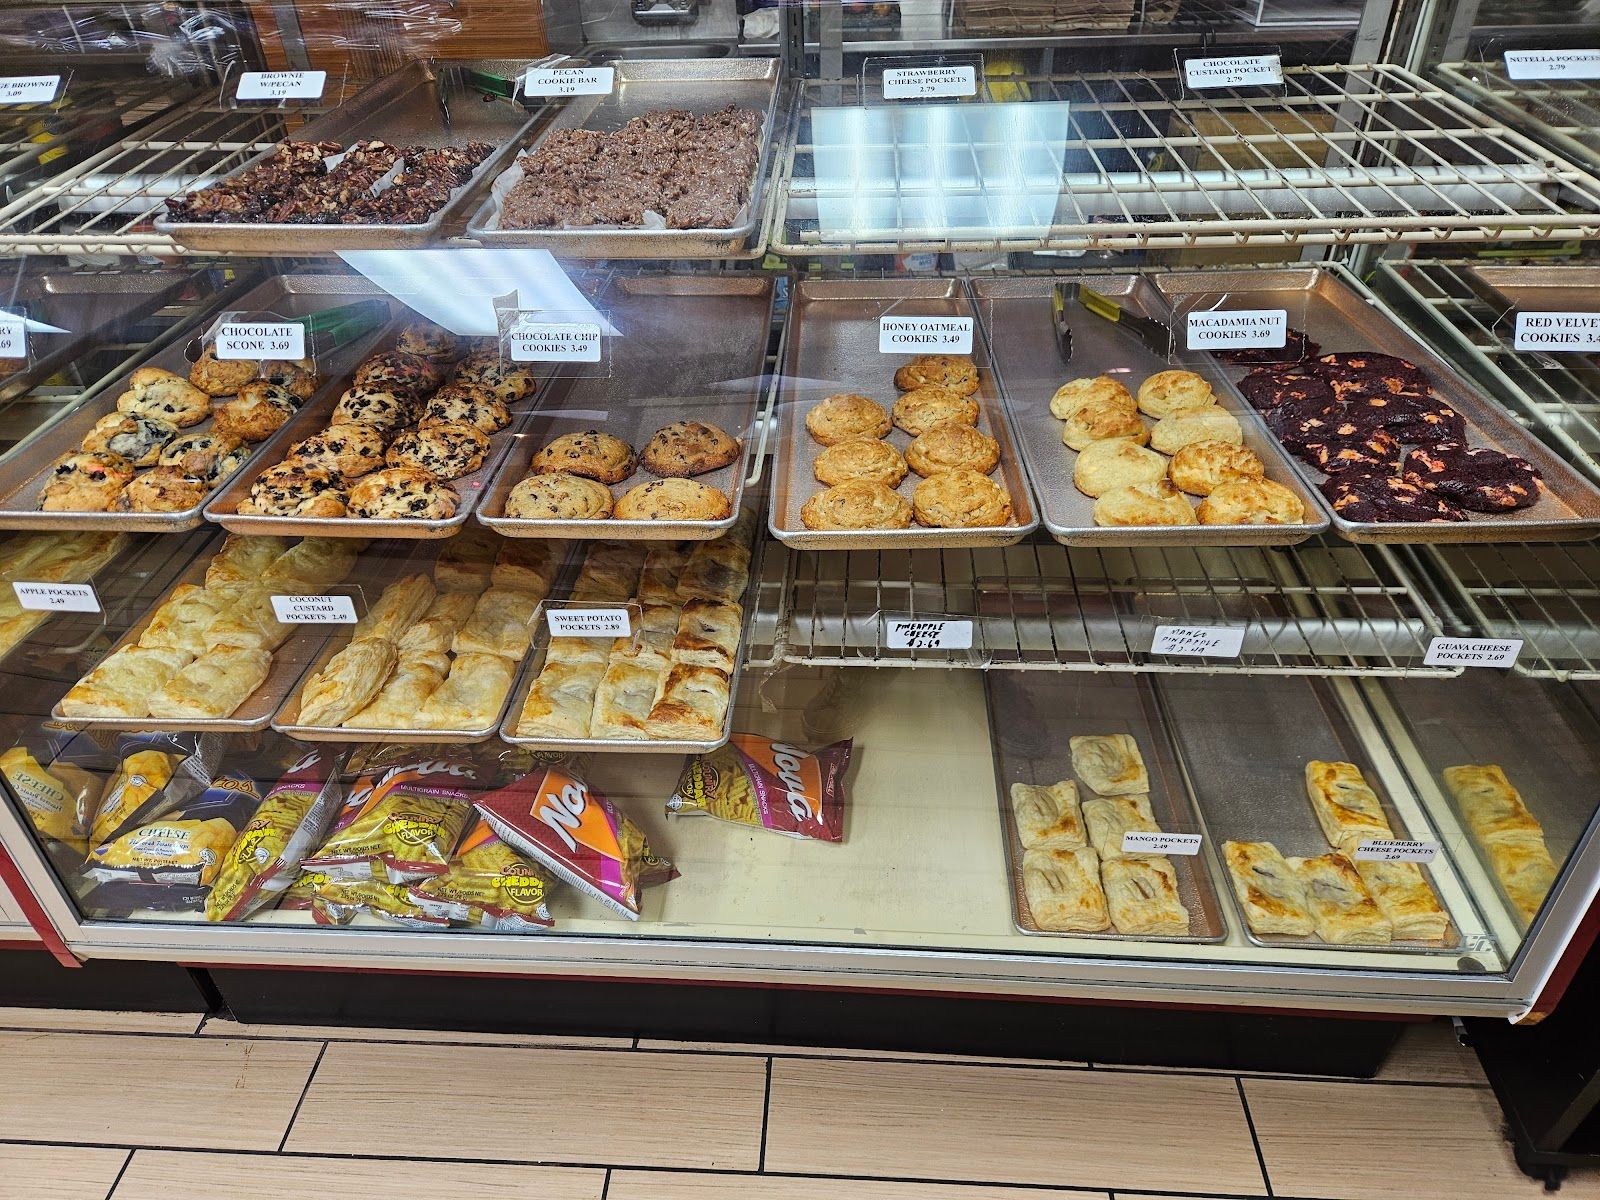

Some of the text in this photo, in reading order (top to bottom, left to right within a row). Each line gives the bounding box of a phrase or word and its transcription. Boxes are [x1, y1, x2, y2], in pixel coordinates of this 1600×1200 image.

[1203, 58, 1261, 67] CHOCOLATE
[896, 68, 958, 76] STRAWBERRY
[1189, 66, 1274, 76] CUSTARD POCKET
[260, 80, 302, 88] W/PECAN
[925, 76, 966, 84] POCKETS
[1189, 317, 1282, 328] MACADAMIA NUT
[1525, 318, 1600, 328] RED VELVE
[222, 327, 292, 336] CHOCOLATE
[882, 323, 970, 332] HONEY OATMEAL
[511, 332, 598, 341] CHOCOLATE CHIP
[892, 334, 960, 343] COOKIES 3.49
[1198, 330, 1270, 339] COOKIES 3.69
[1520, 333, 1580, 342] COOKIES
[226, 340, 290, 350] SCONE 3.69
[522, 344, 588, 352] COOKIES 3.49
[896, 622, 945, 632] PINEAPPLE
[1472, 644, 1512, 652] CHEESE
[1436, 652, 1483, 660] POCKETS
[138, 828, 191, 840] CHEESE
[401, 829, 434, 840] FLAVOR
[1160, 836, 1199, 844] POCKETS
[491, 876, 544, 888] CHEDD
[510, 888, 544, 897] FLAVOR
